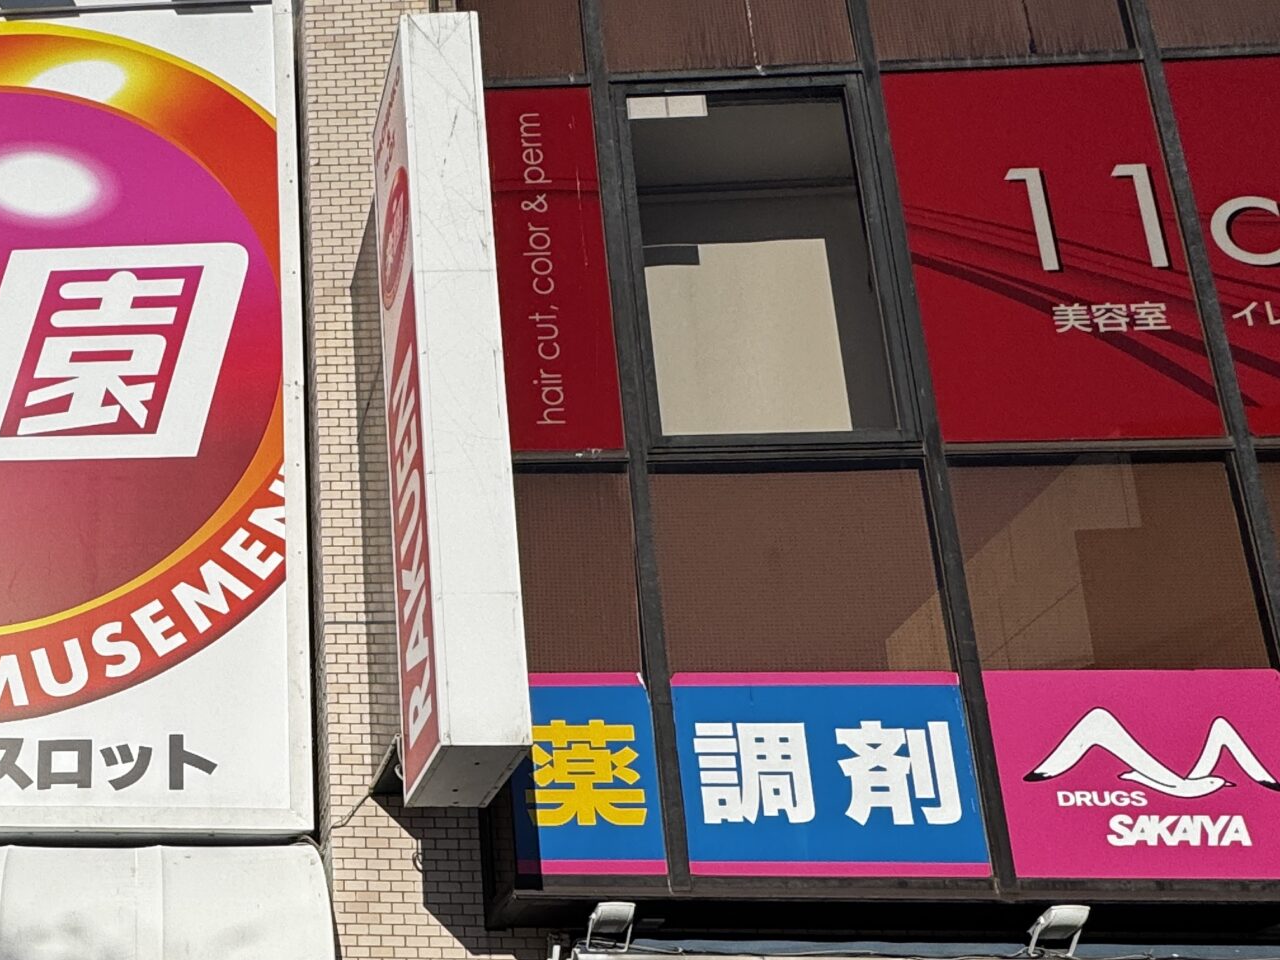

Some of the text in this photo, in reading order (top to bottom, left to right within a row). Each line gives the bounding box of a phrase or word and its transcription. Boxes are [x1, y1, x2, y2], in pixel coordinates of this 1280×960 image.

[519, 112, 566, 425] hair cut, color & perm
[1052, 301, 1172, 333] 美容室
[392, 342, 433, 750] RAKUEN
[527, 719, 647, 826] 薬
[693, 720, 964, 826] 調剤
[1057, 790, 1148, 807] DRUGS
[1107, 815, 1252, 848] SAKAIYA
